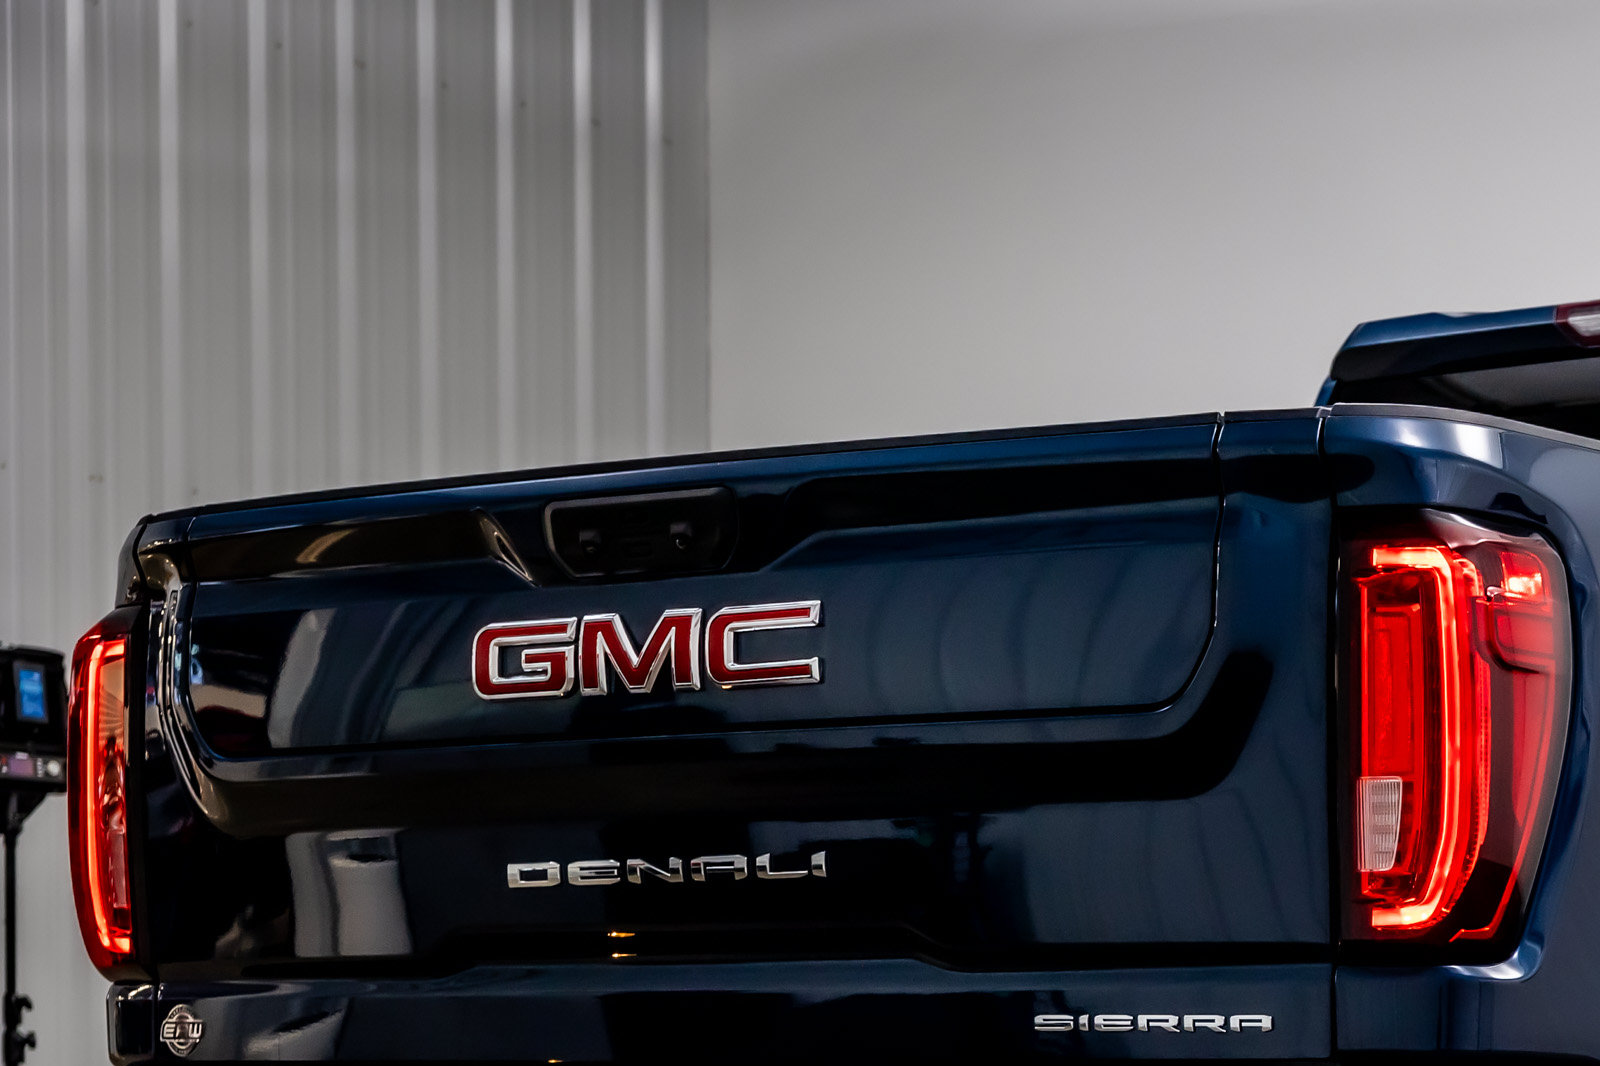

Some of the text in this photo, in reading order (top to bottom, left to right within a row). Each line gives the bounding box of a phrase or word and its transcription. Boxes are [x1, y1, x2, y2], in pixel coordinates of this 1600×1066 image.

[472, 600, 821, 700] GMC
[508, 851, 827, 888] DENALI
[1034, 1013, 1273, 1033] SIERRA
